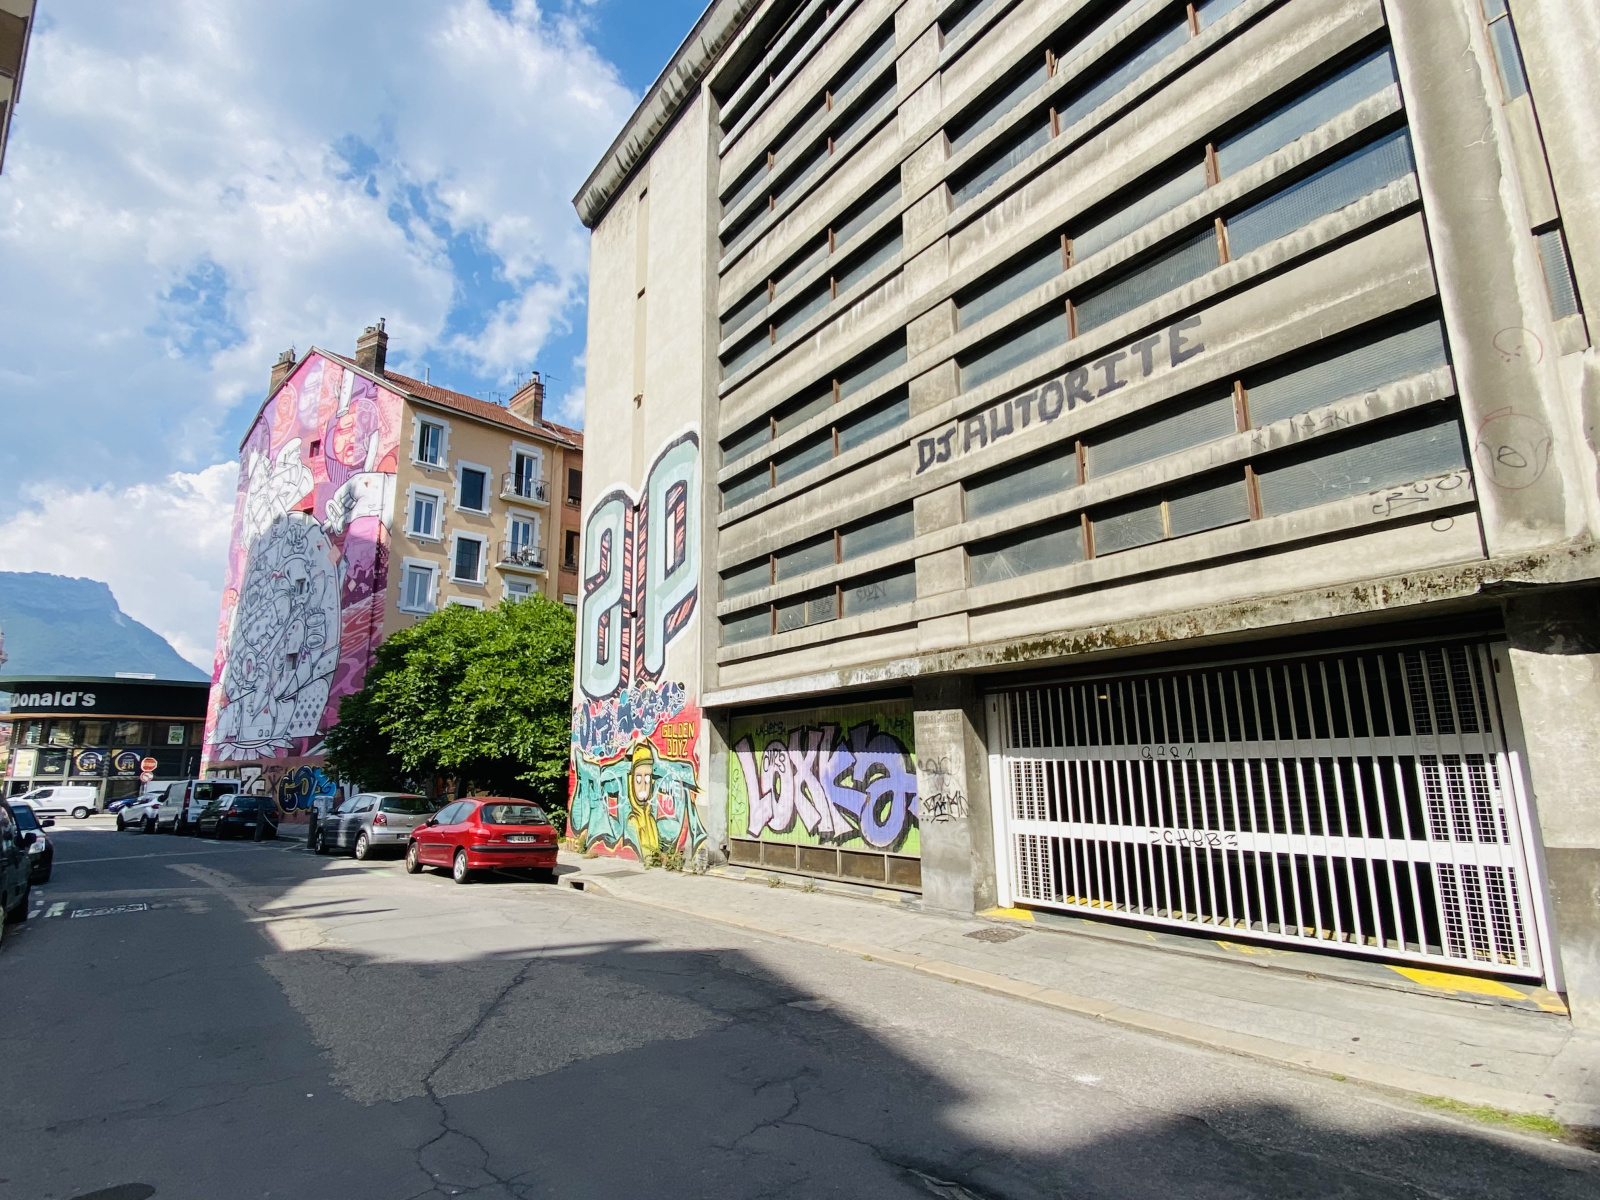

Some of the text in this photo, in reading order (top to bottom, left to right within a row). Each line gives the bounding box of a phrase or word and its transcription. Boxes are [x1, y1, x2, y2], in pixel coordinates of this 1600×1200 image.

[915, 315, 1205, 475] DJ AUTORITE
[661, 722, 695, 739] GOLDEN
[667, 739, 689, 757] BOYZ
